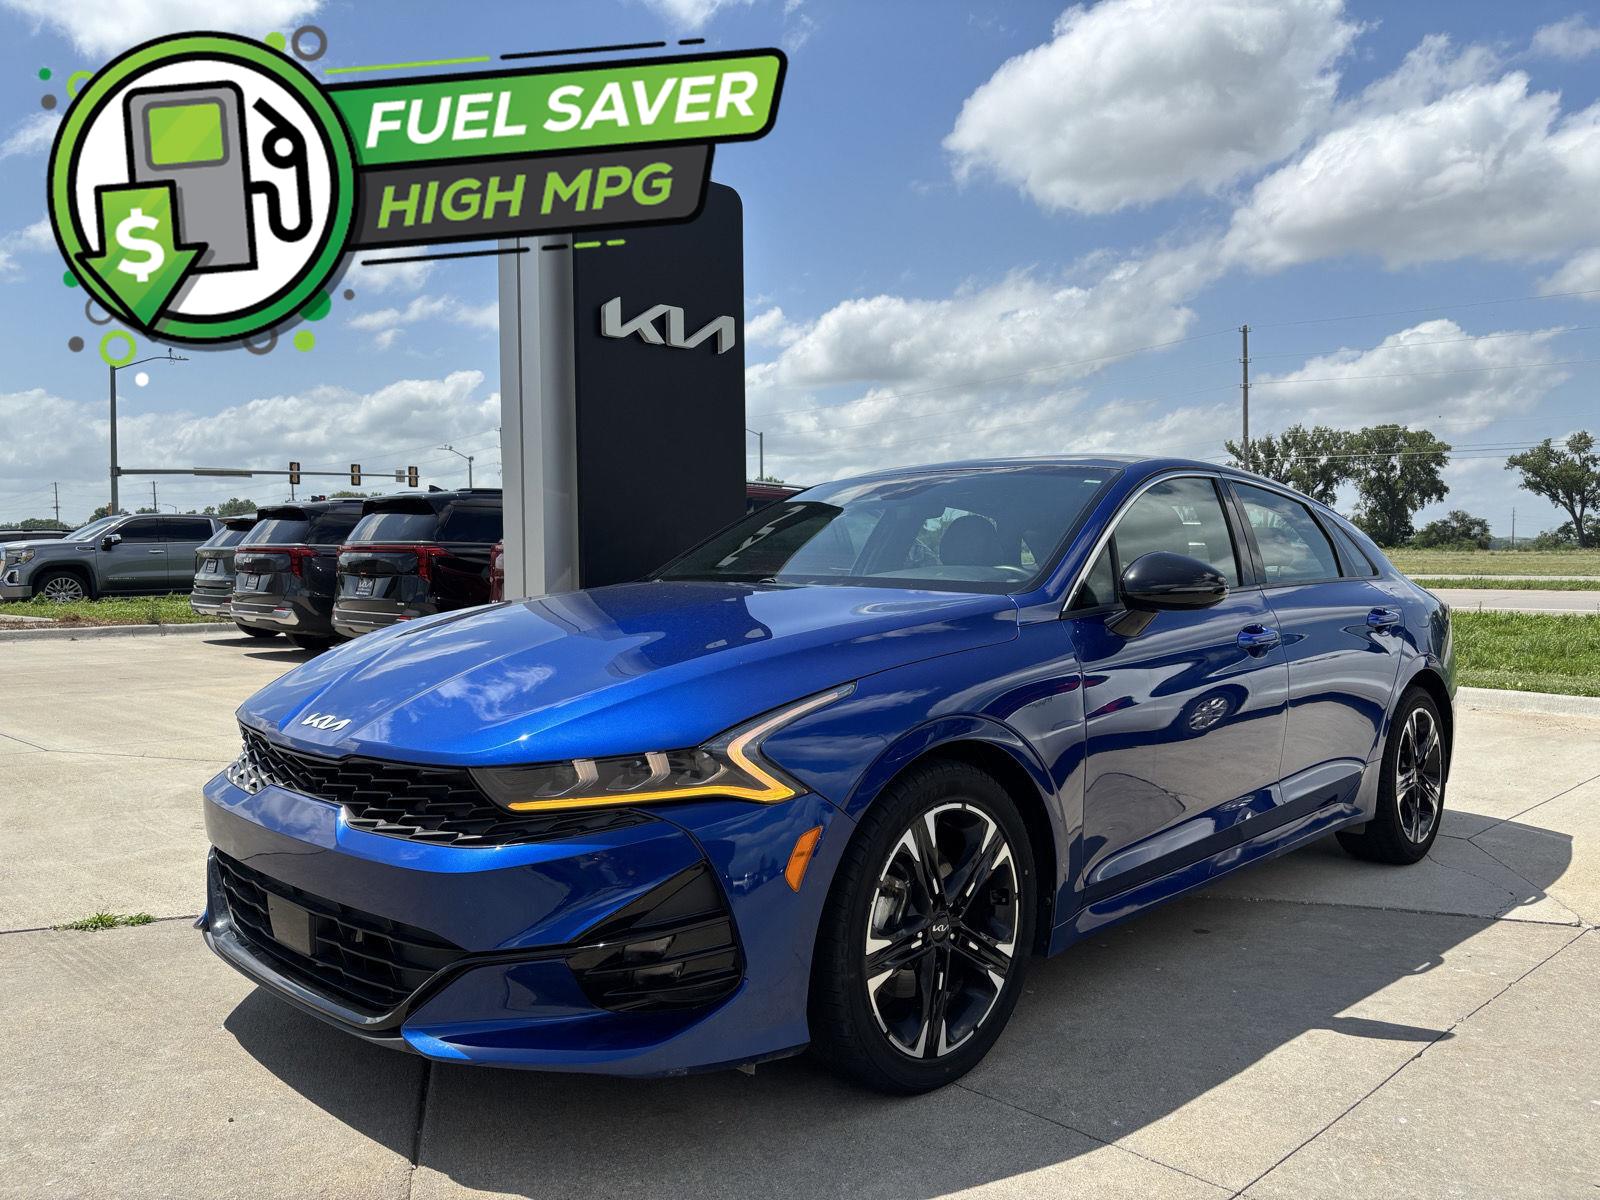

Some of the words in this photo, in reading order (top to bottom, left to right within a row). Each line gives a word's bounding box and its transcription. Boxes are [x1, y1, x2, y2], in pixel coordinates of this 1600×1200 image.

[600, 296, 736, 355] KIA
[301, 712, 352, 732] KIA
[932, 924, 949, 932] KIA
